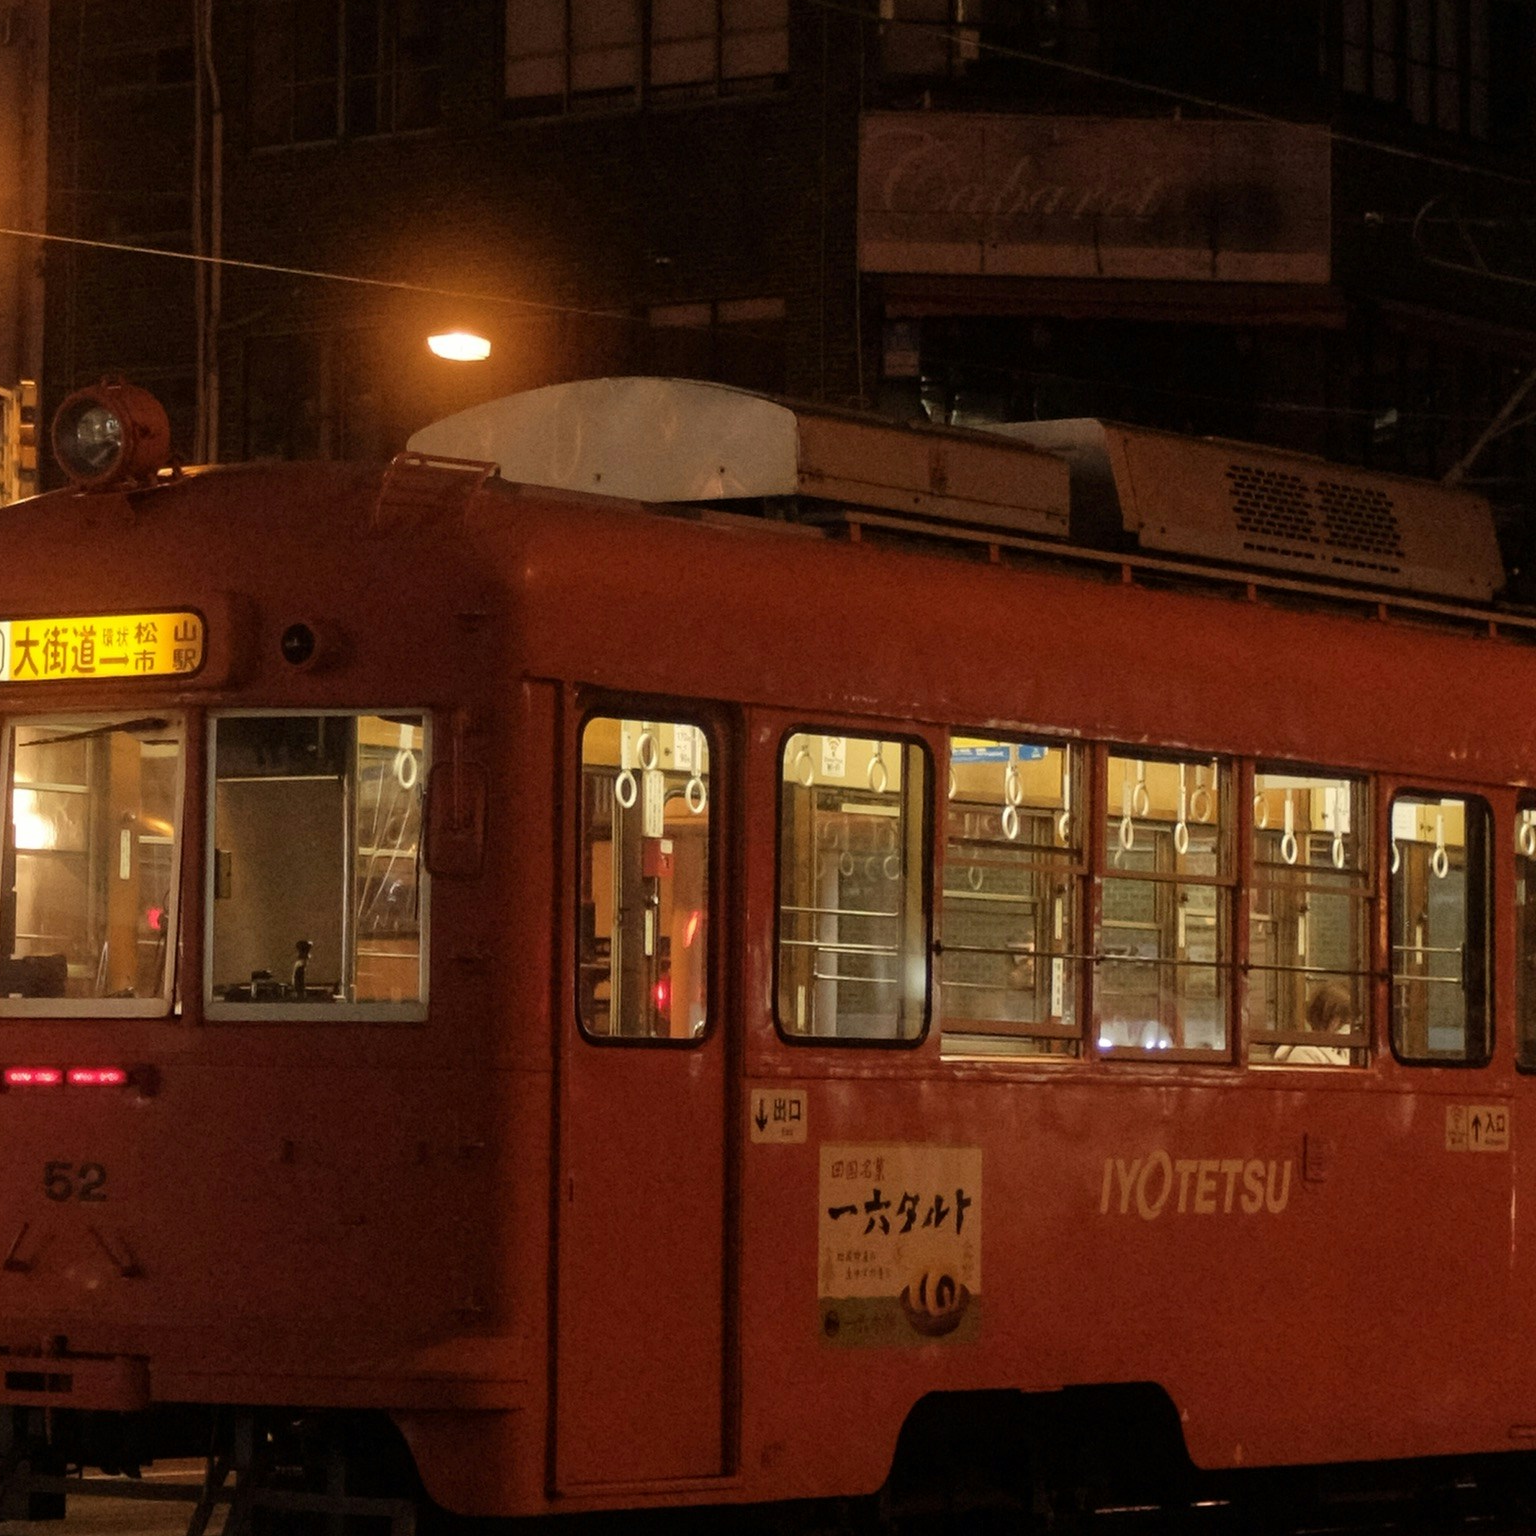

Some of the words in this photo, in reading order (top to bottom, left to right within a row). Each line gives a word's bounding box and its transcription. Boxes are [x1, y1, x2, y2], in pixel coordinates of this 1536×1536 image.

[14, 624, 97, 677] 大街道
[773, 1098, 801, 1123] 出口
[44, 1162, 109, 1203] 52
[1100, 1149, 1293, 1221] IYOTETSU
[828, 1188, 972, 1236] 一六タルト
